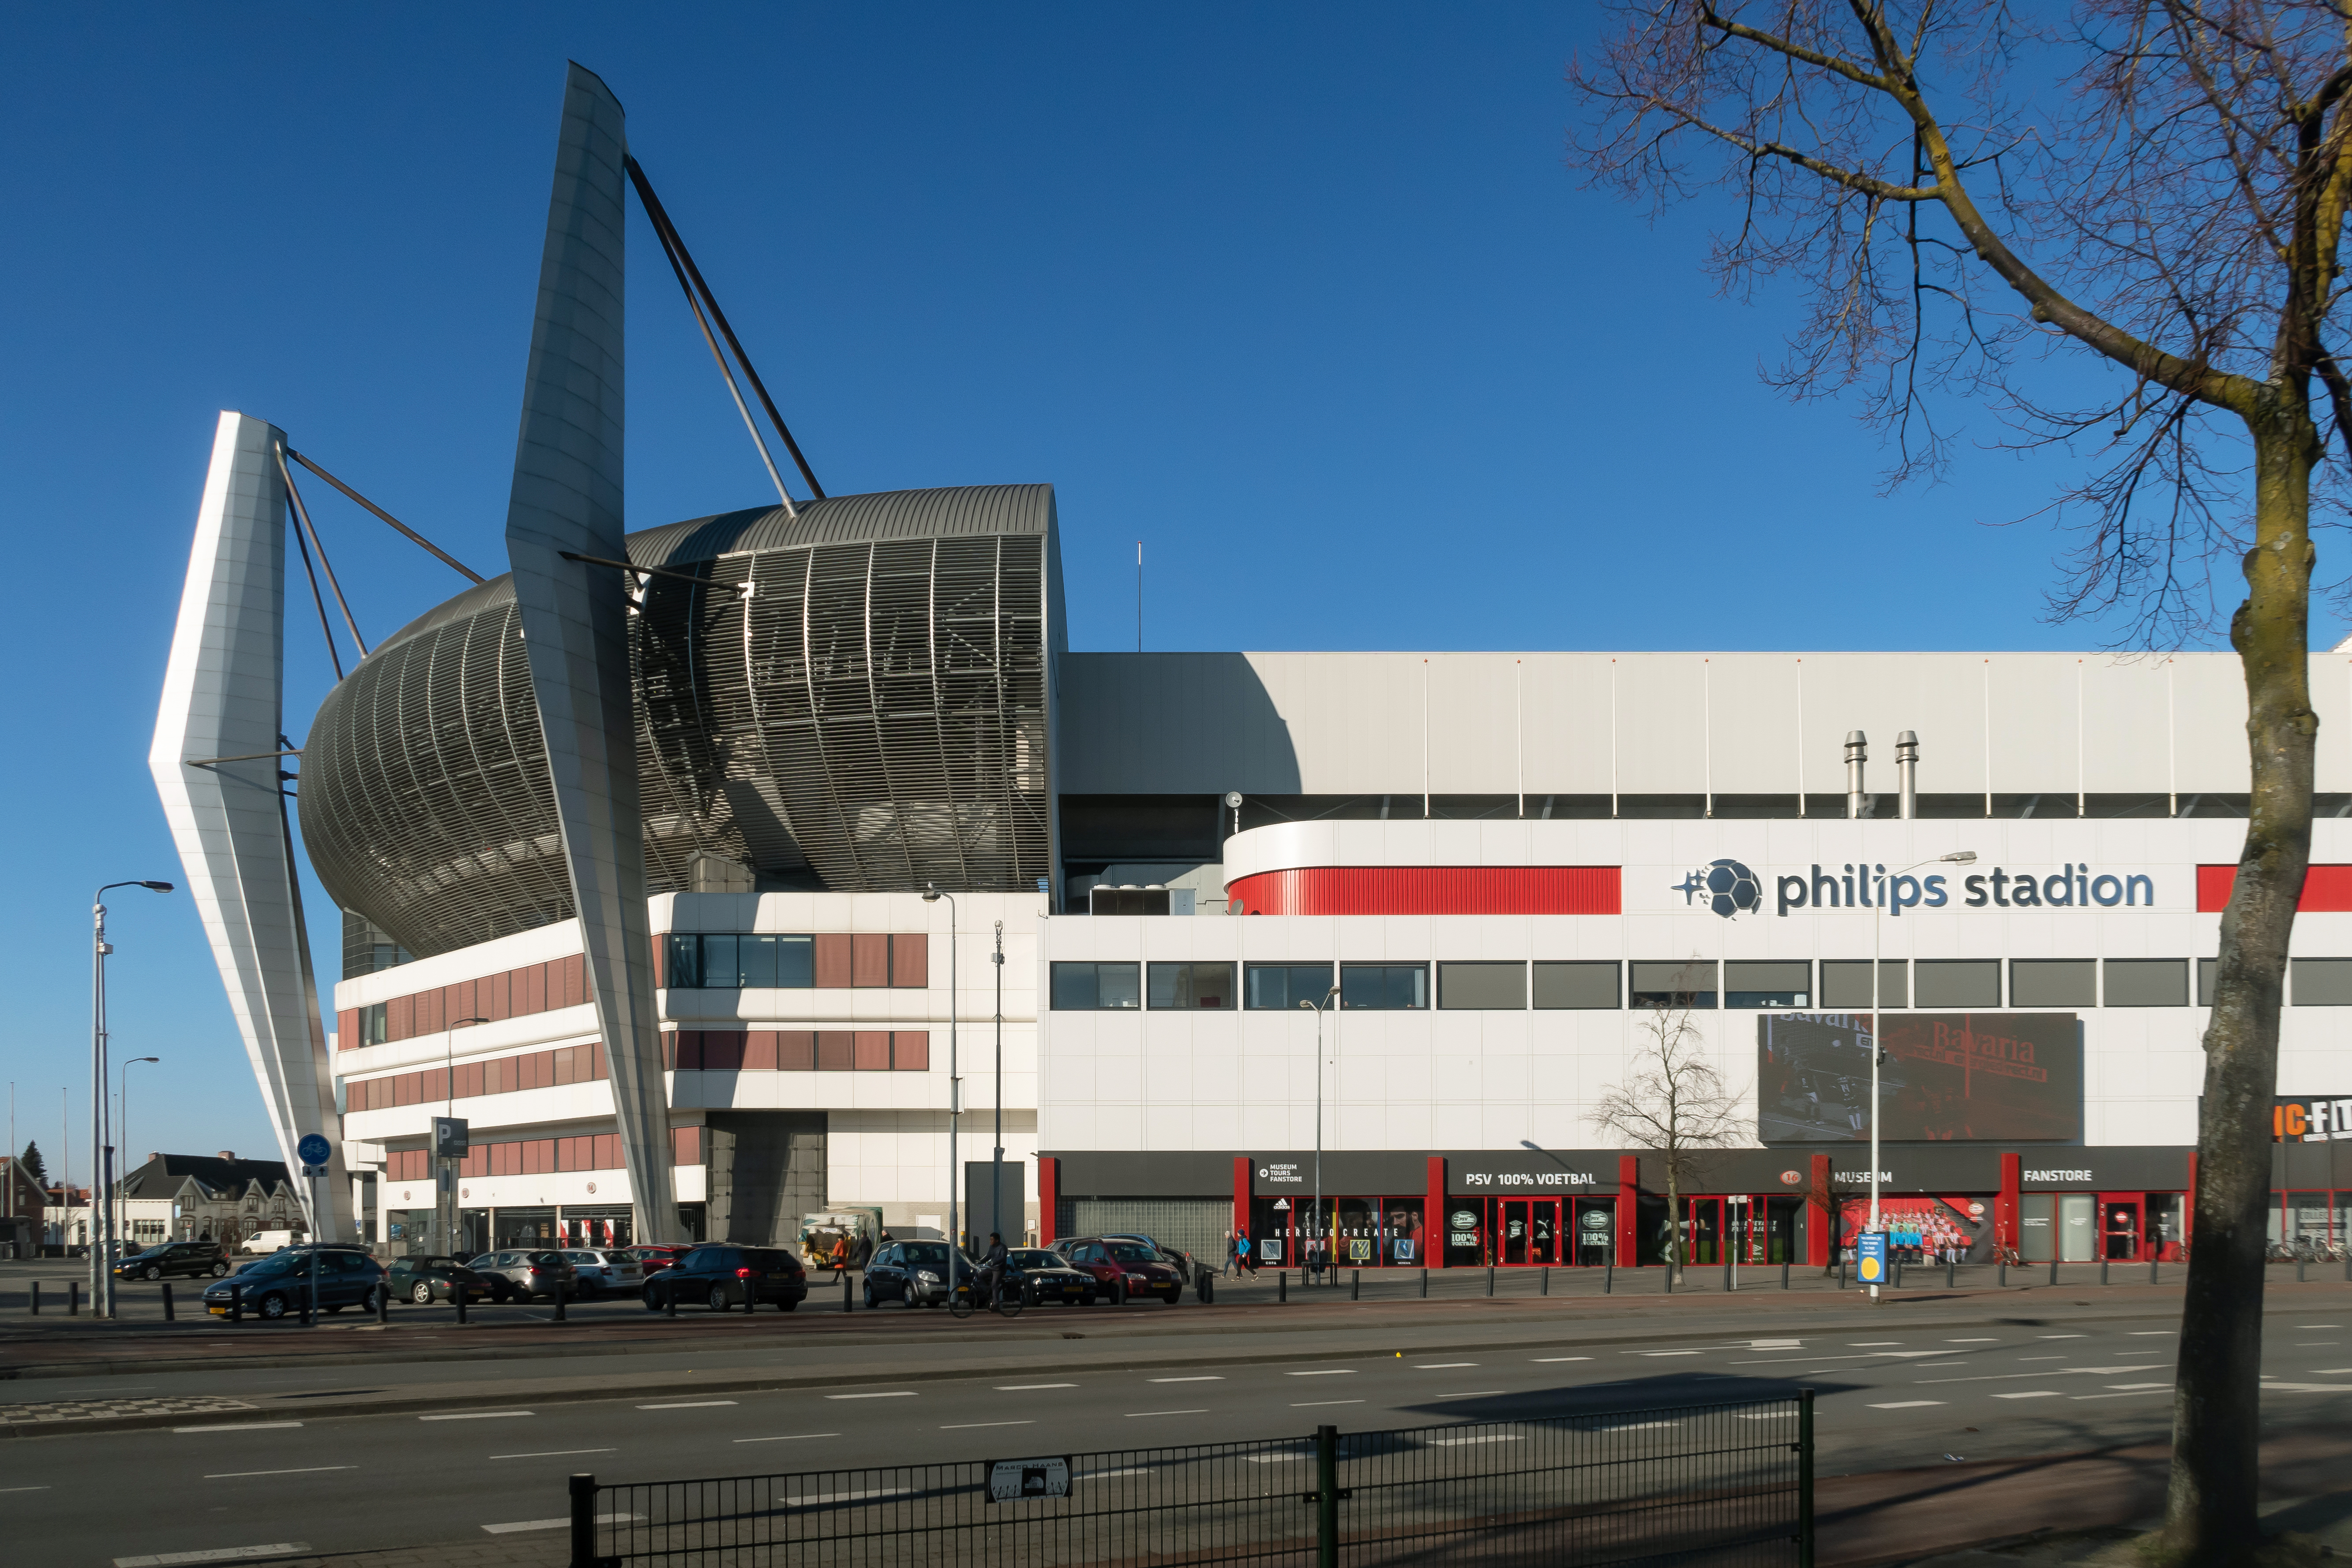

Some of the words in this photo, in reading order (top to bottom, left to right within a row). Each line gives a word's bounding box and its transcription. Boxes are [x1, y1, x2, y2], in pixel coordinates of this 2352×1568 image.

[1777, 863, 1949, 916] philips
[1964, 863, 2153, 907] stadion
[1934, 1021, 2035, 1063] Bavaria
[439, 1124, 451, 1144] P
[1466, 1174, 1492, 1185] PSV
[1498, 1174, 1534, 1185] 100%
[1536, 1173, 1596, 1185] VOETBAL
[1787, 1173, 1798, 1182] 16
[2024, 1170, 2092, 1182] FANSTORE
[1275, 1228, 1310, 1237] HERE
[1320, 1228, 1334, 1237] TO
[1343, 1228, 1399, 1237] CREATE
[1583, 1233, 1609, 1241] 100%
